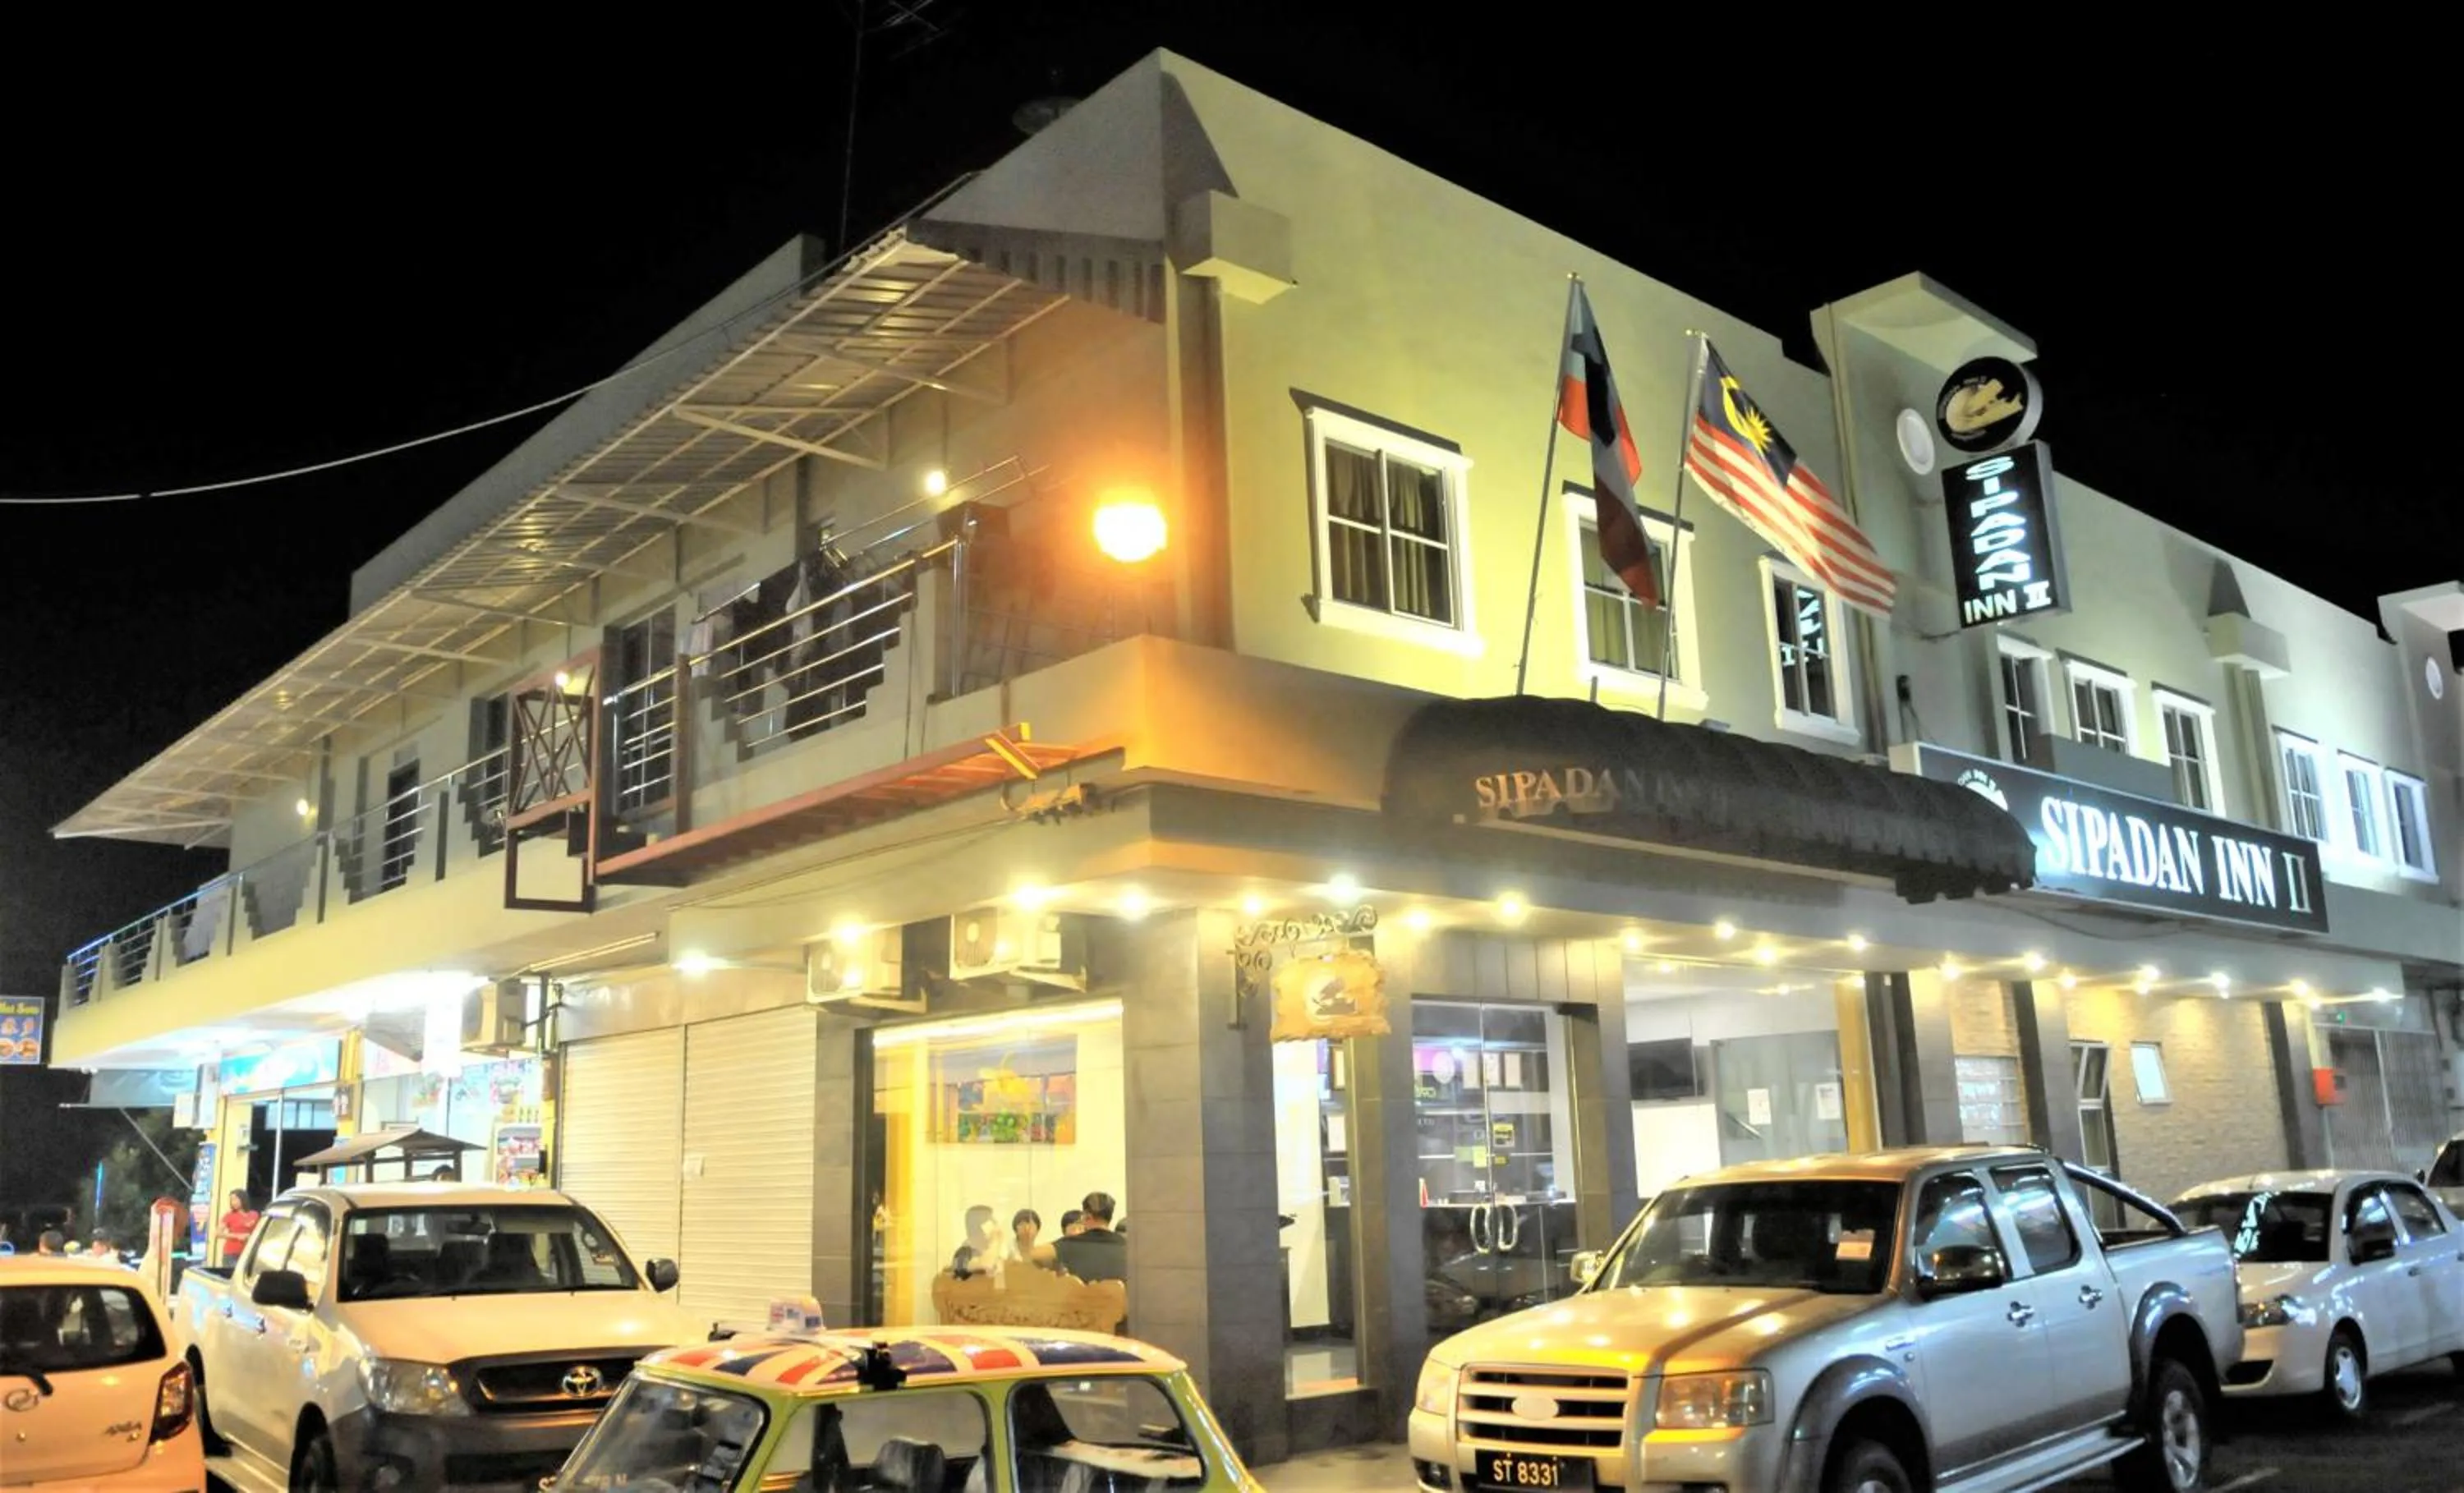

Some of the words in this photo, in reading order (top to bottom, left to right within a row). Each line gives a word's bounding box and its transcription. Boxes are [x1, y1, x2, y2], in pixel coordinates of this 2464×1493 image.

[1965, 455, 2031, 590] SIPADAN
[1964, 590, 2016, 624] INN
[2023, 580, 2053, 610] II
[1475, 767, 1643, 808] SIPADAN
[2040, 796, 2205, 896] SIPADAN
[2210, 835, 2277, 909] INN
[2282, 852, 2314, 915] II
[1492, 1458, 1513, 1483] ST
[1517, 1459, 1559, 1487] 8331
